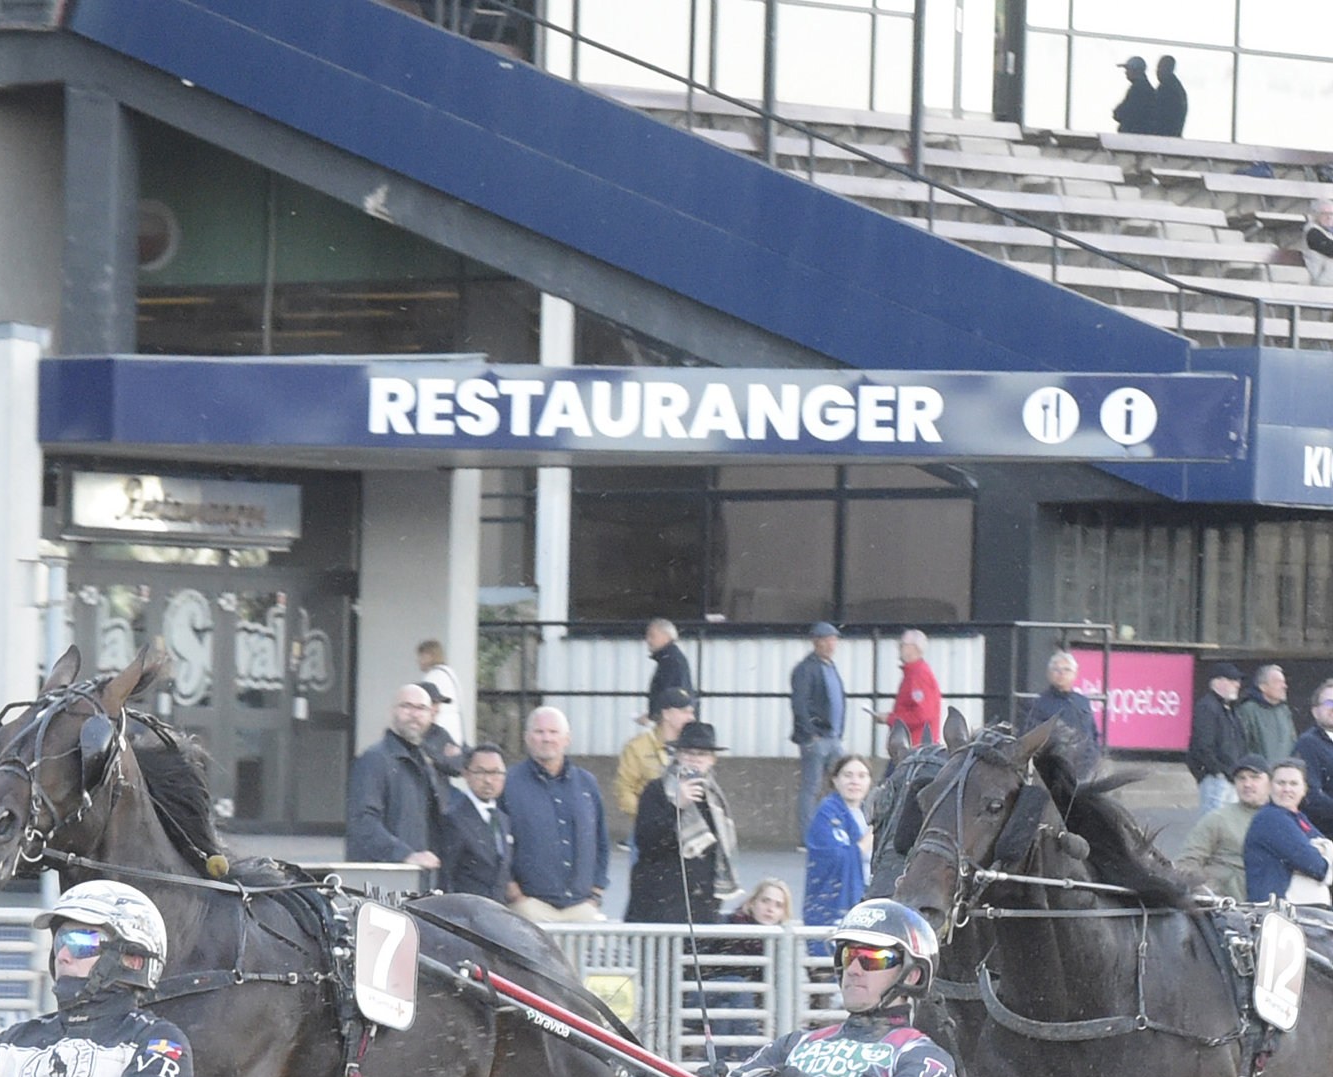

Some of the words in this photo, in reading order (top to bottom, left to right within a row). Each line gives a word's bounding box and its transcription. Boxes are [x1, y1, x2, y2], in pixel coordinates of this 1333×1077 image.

[369, 377, 944, 443] RESTAURANGER
[1304, 445, 1333, 488] KI
[369, 906, 406, 992] 7
[1263, 915, 1304, 1008] 12
